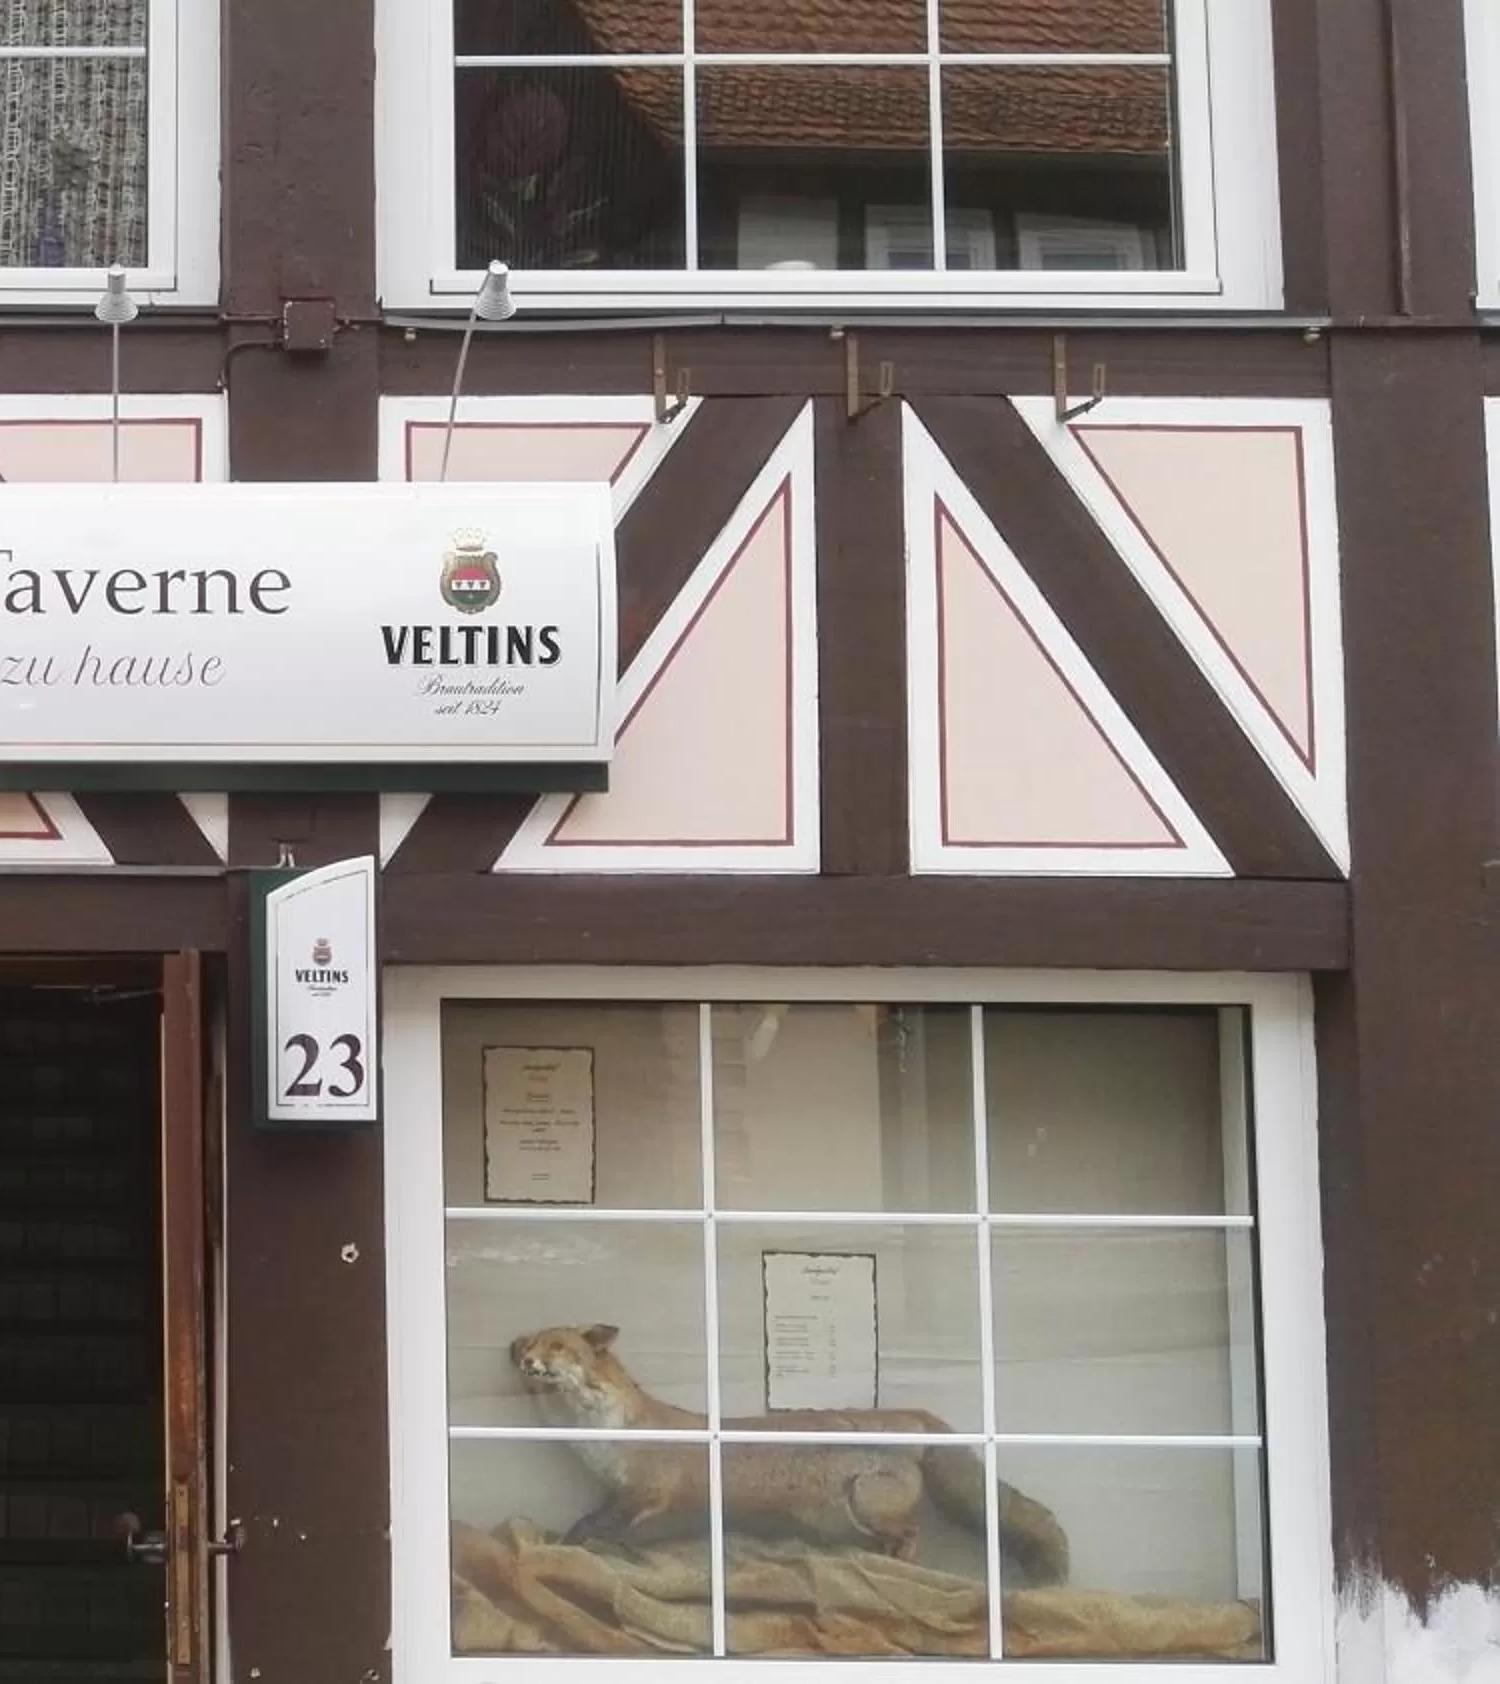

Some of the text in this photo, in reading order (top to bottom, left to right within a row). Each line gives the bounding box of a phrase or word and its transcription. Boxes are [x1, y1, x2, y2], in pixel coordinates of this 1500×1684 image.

[0, 654, 61, 686] zu
[73, 644, 227, 687] hause
[380, 625, 562, 666] VELTINS
[433, 699, 501, 716] seit 1824
[295, 968, 350, 984] VELTINS
[284, 1033, 365, 1098] 23
